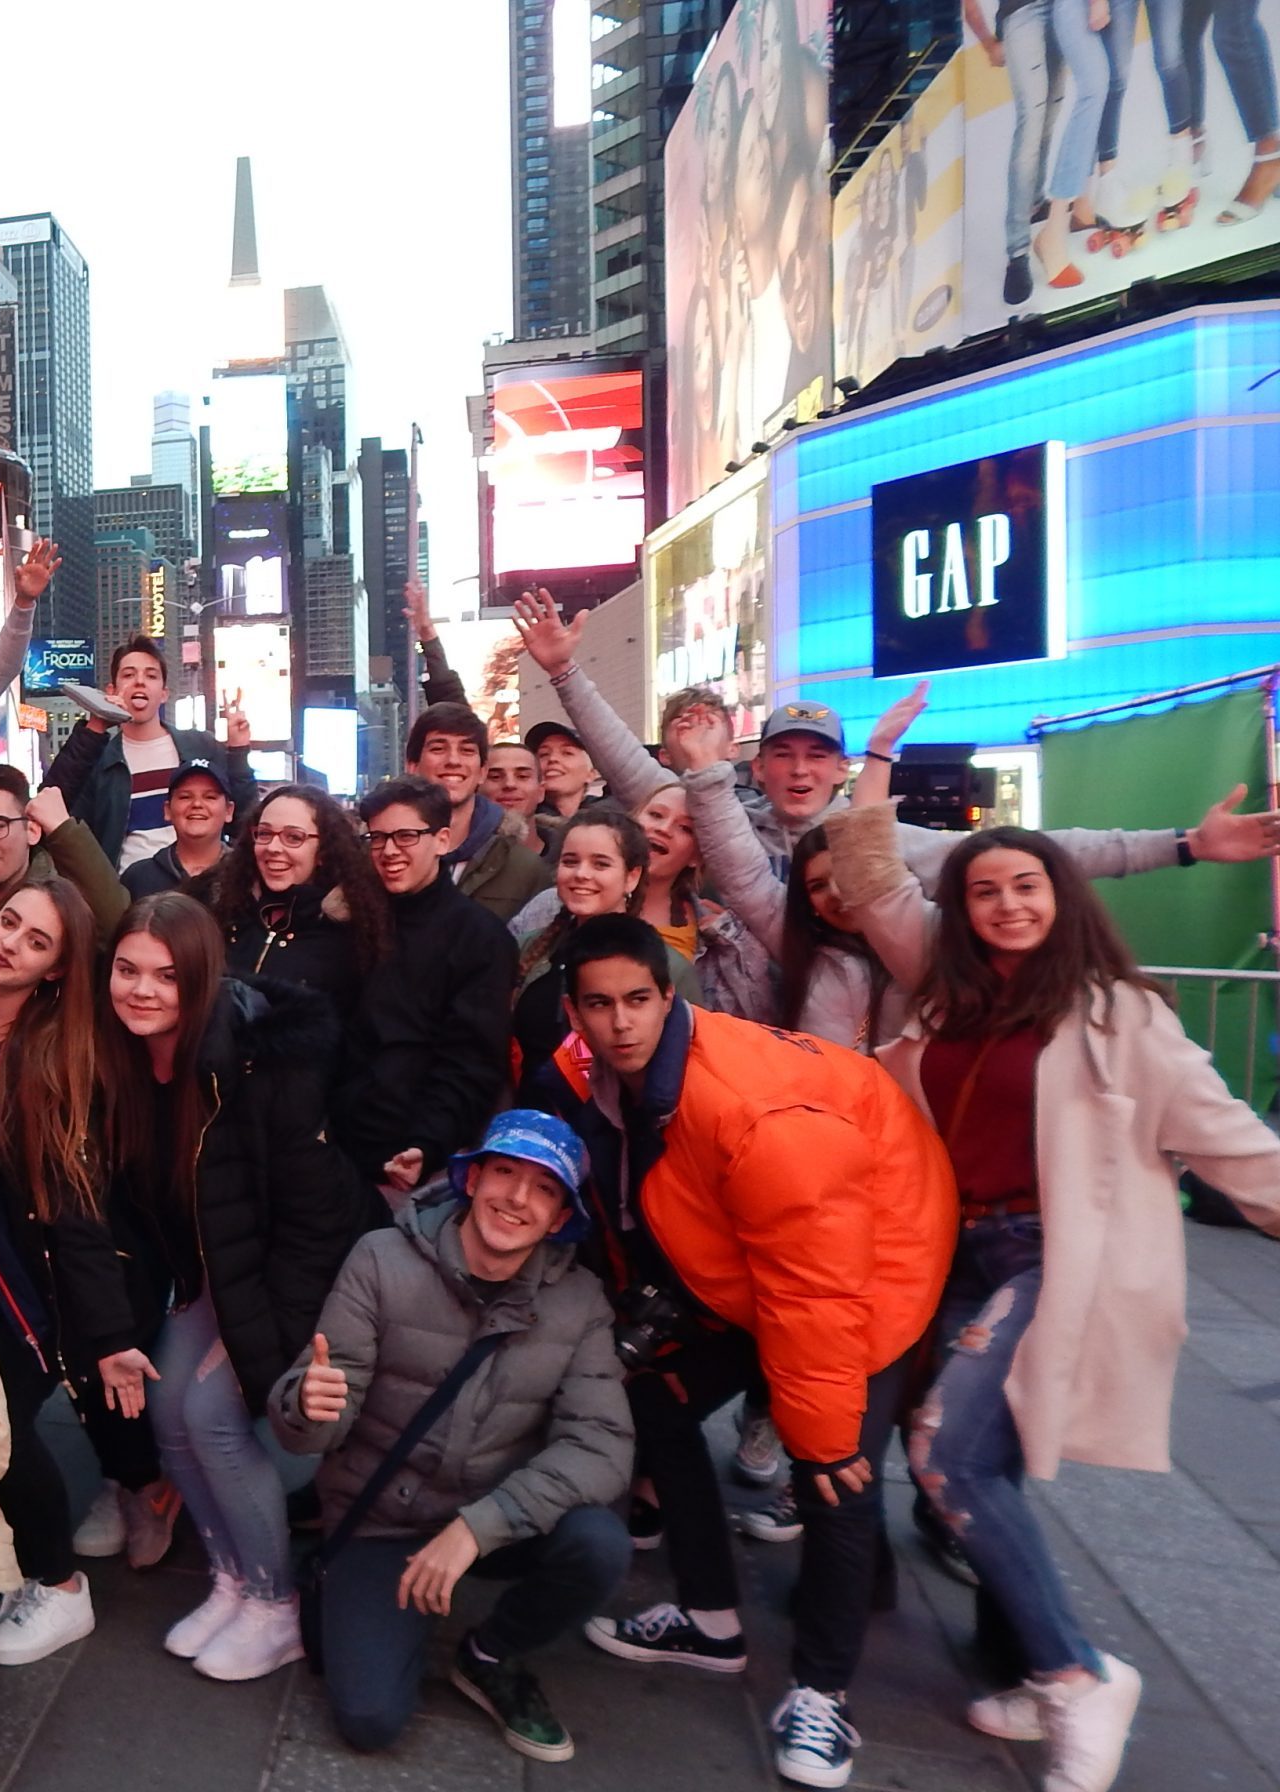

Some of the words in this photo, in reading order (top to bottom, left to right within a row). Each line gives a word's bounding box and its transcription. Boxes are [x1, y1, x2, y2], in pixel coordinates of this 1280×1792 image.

[150, 566, 165, 638] NOVOTEL
[903, 513, 1010, 619] GAP
[43, 650, 94, 669] FROZEN
